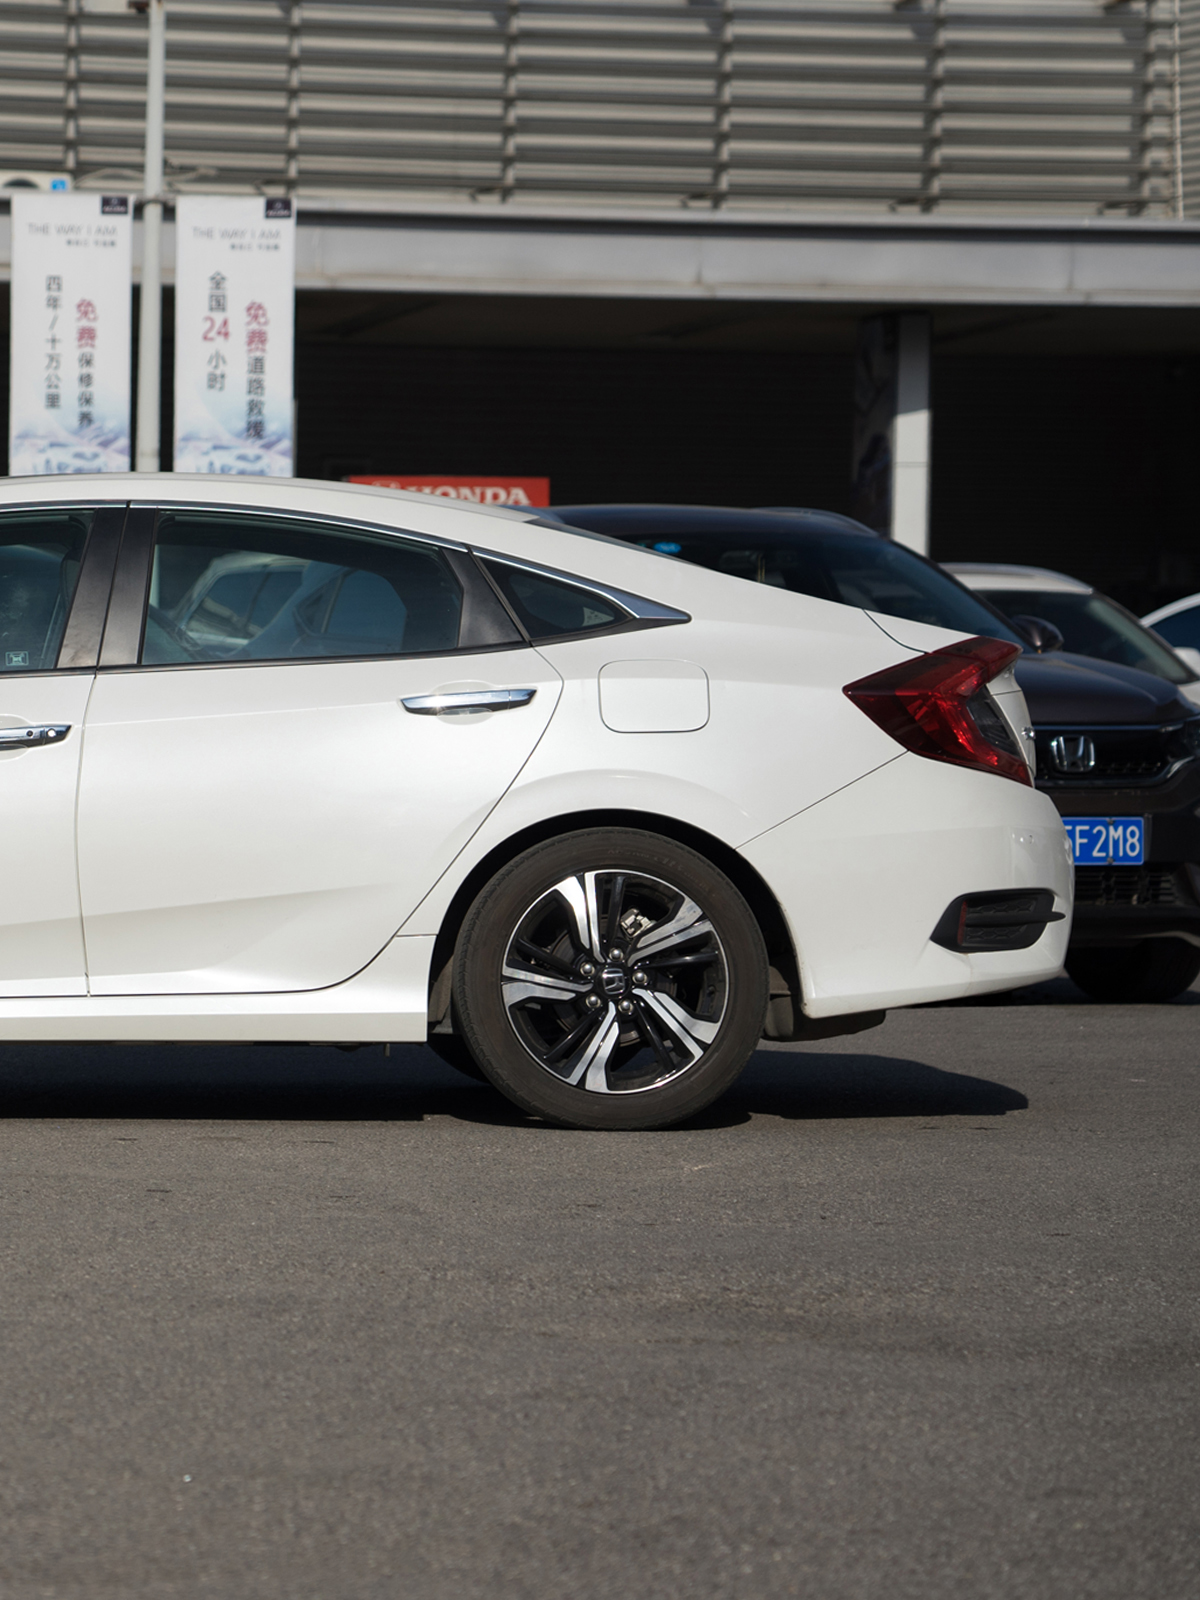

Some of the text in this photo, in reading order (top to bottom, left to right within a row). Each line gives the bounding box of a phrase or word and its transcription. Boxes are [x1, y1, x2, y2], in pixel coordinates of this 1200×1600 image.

[27, 223, 49, 235] THE
[192, 226, 213, 238] THE
[45, 274, 63, 410] 四年/十万公里
[76, 297, 98, 427] 免费保修保养
[202, 270, 230, 391] 全国24小时
[245, 300, 269, 440] 免费道路救援
[1064, 825, 1140, 857] F2M8
